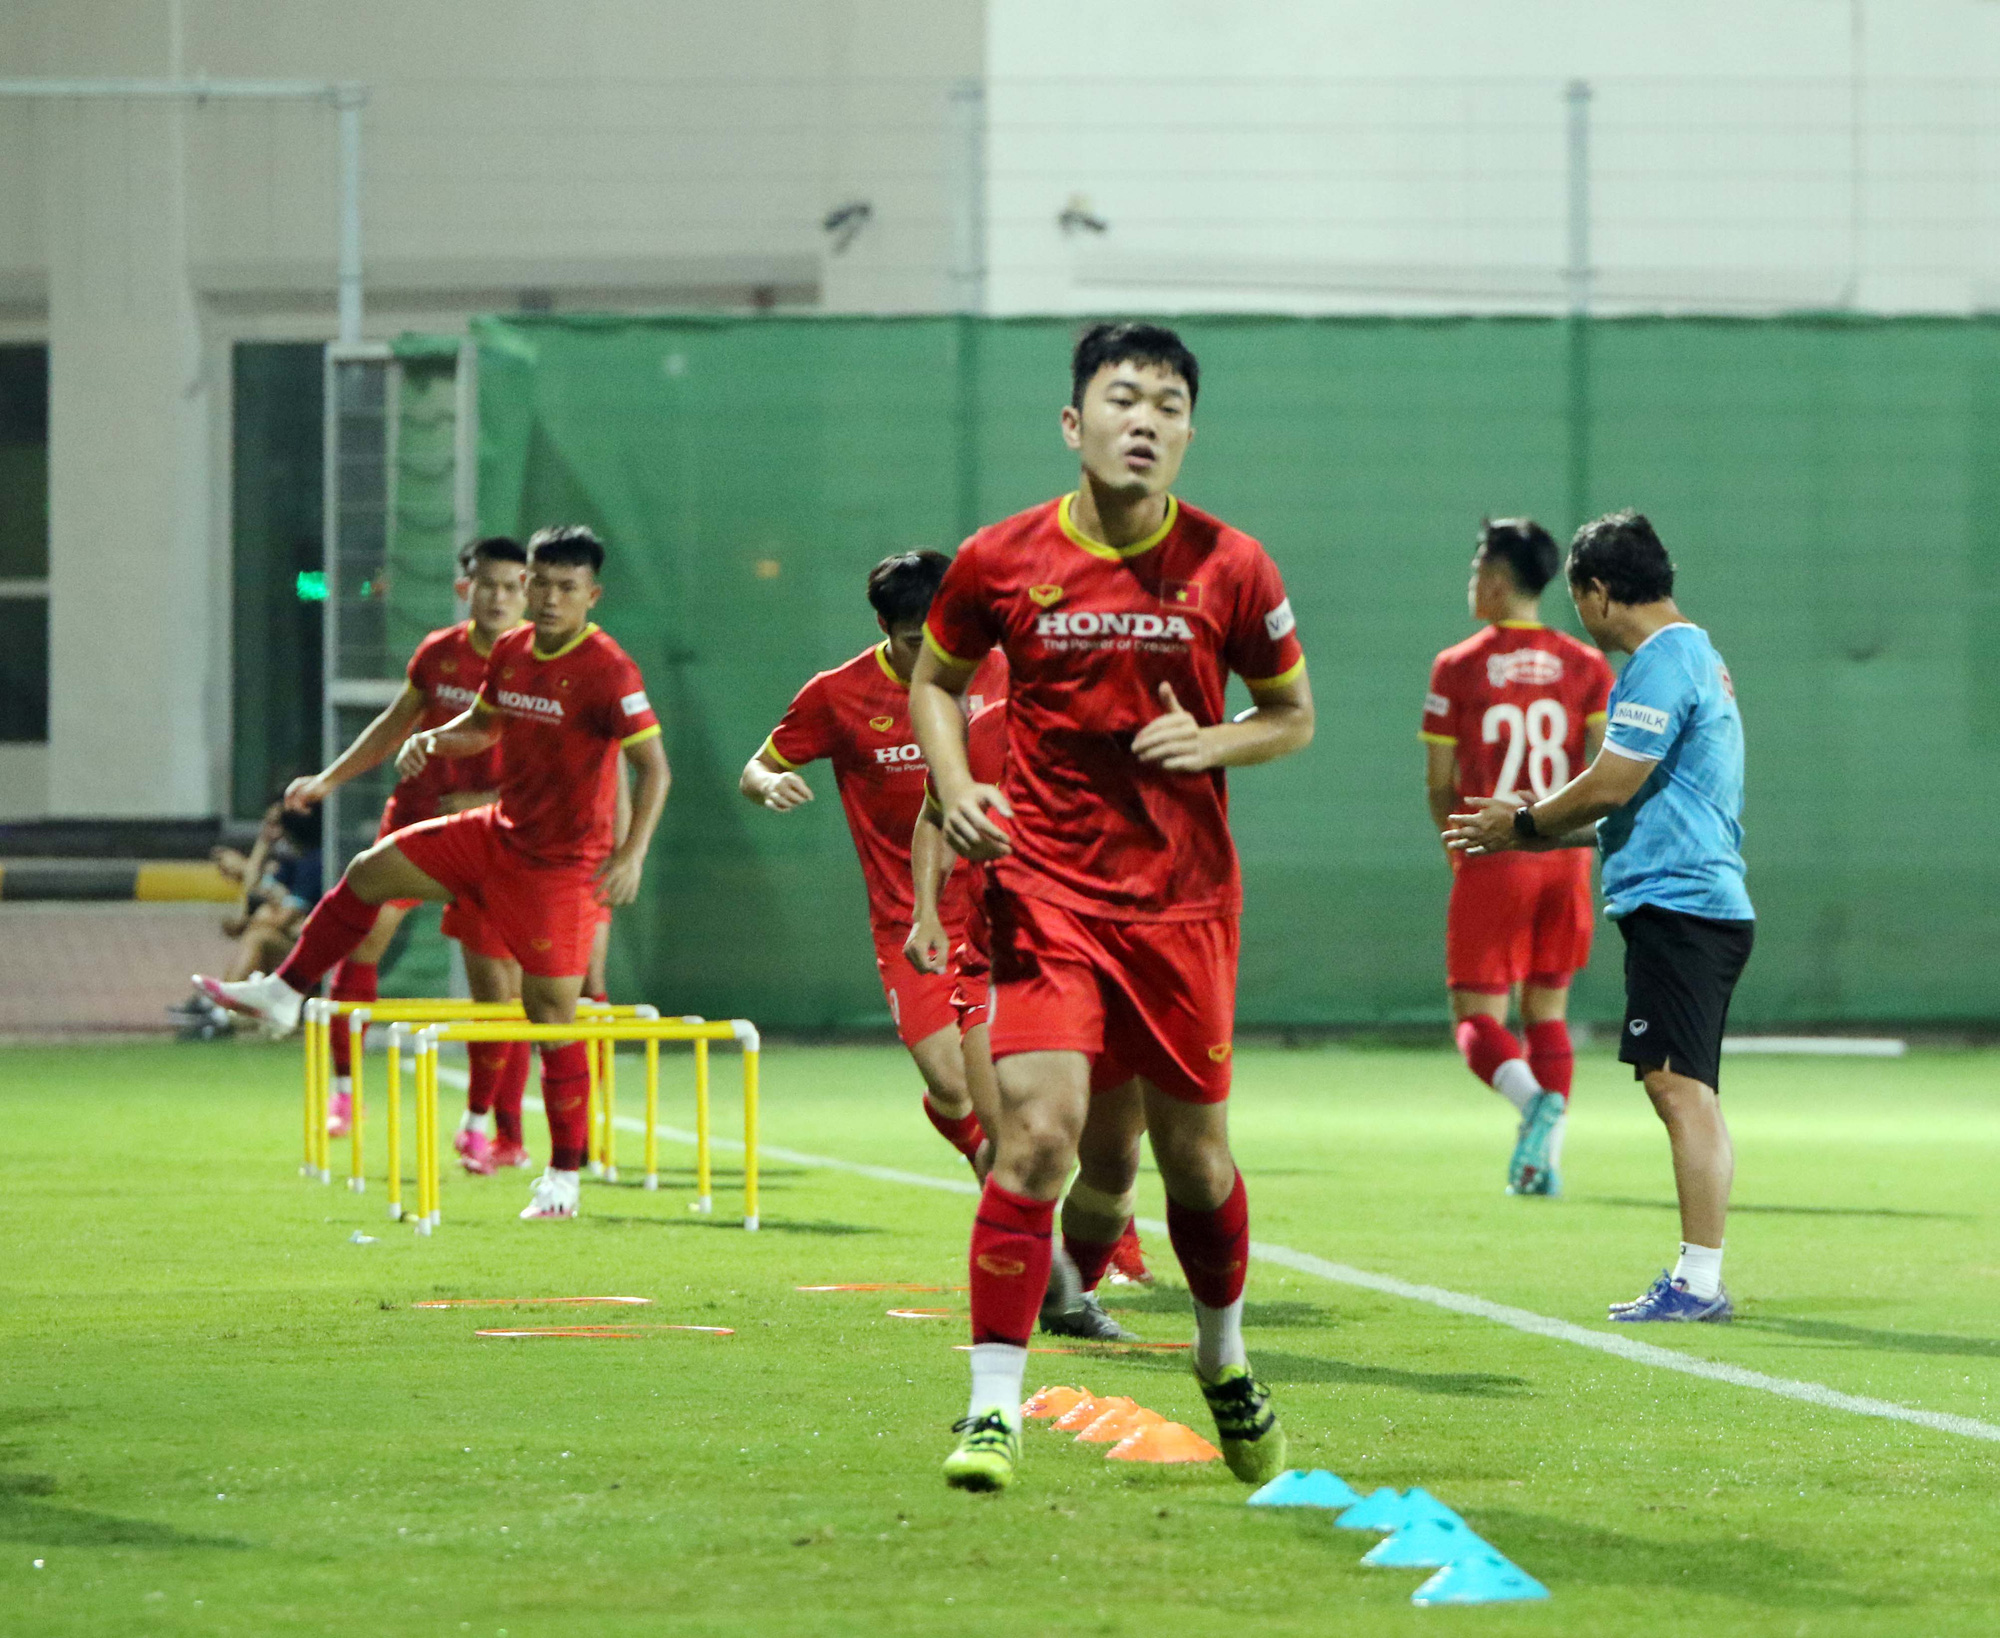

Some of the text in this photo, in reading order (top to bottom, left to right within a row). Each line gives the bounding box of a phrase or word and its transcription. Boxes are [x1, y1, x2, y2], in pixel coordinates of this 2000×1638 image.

[1036, 612, 1195, 639] HONDA
[1043, 638, 1068, 650] The
[874, 744, 923, 763] HO
[1482, 698, 1569, 805] 28
